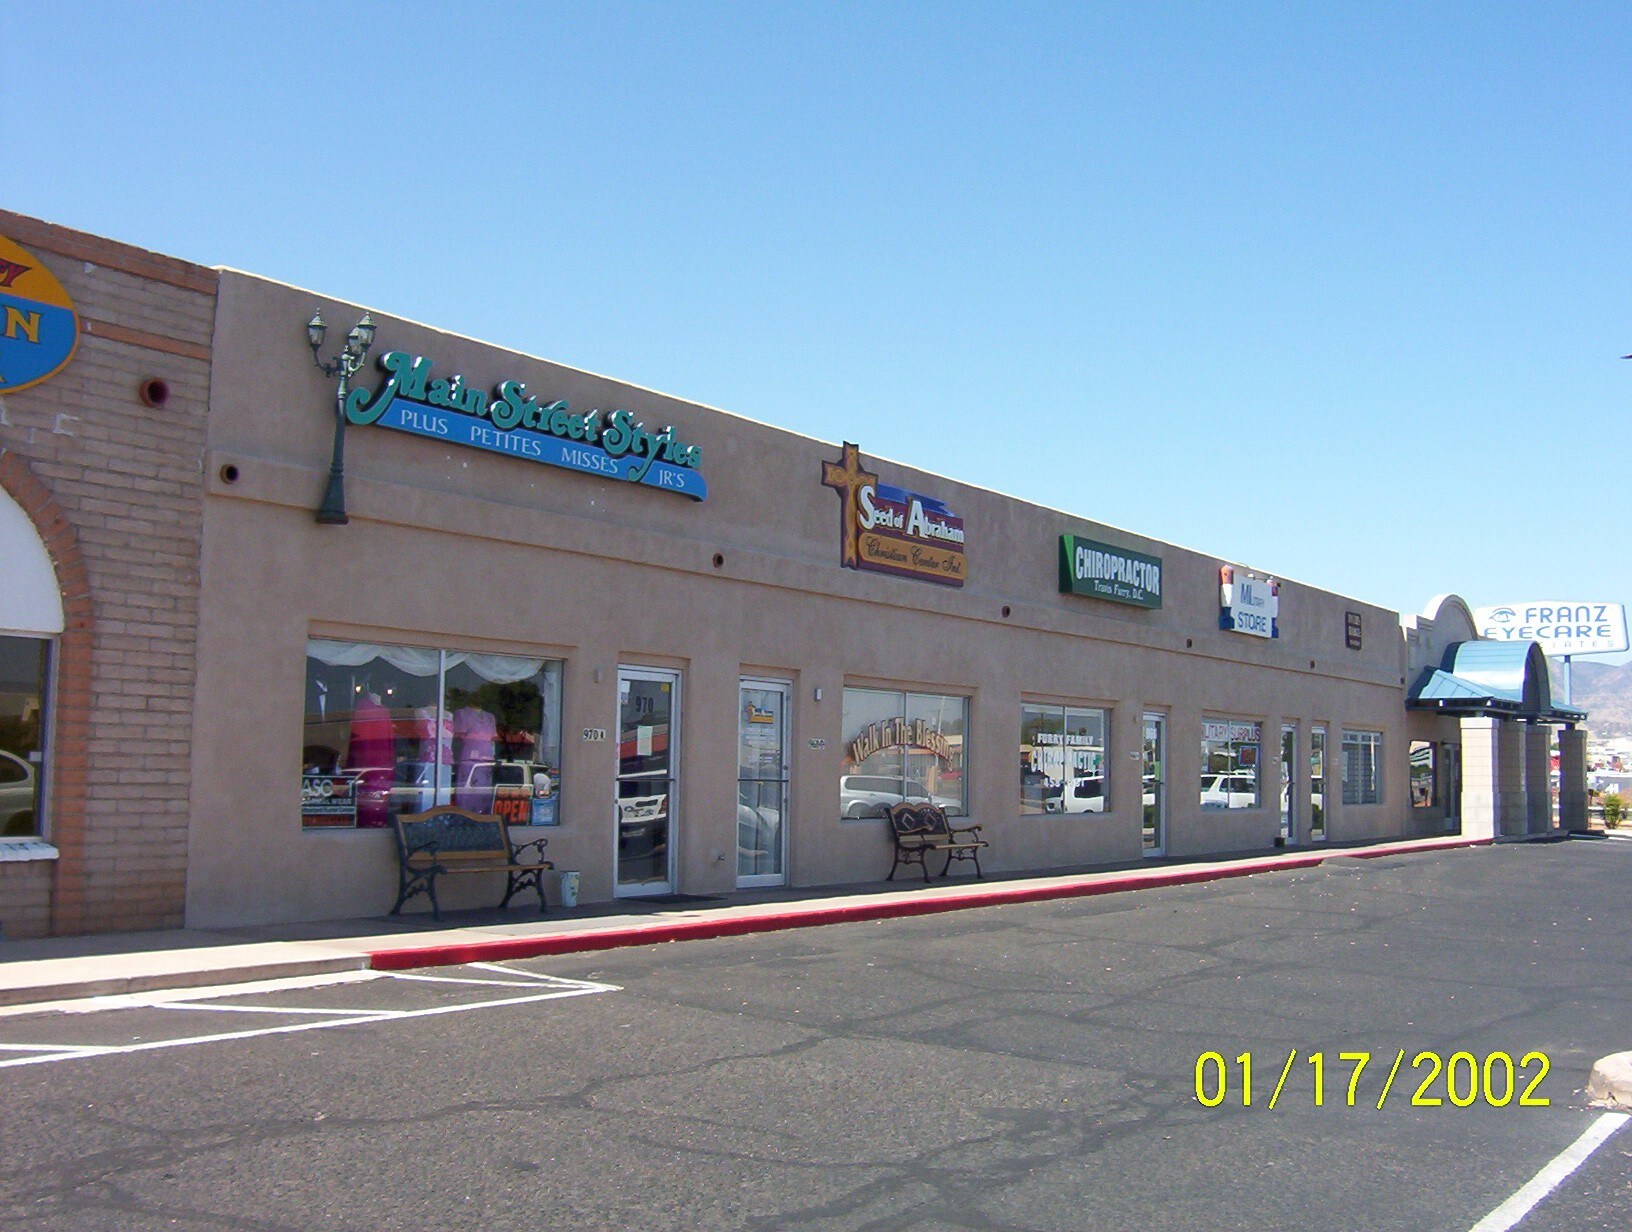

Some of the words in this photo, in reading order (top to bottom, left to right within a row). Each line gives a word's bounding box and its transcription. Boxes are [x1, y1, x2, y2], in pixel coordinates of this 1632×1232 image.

[346, 351, 488, 425] Main
[490, 380, 600, 442] Street
[602, 409, 702, 482] Styles
[400, 408, 449, 435] PLUS
[470, 425, 542, 457] PETITES
[560, 446, 619, 475] MISSES
[658, 468, 686, 489] JR'S
[858, 485, 893, 529] Seed
[907, 499, 964, 544] Abraham
[1075, 545, 1160, 596] CHIROPRACTOR
[1237, 611, 1267, 632] STORE
[1483, 624, 1611, 640] EYECARE
[1525, 605, 1608, 623] FRANZ
[635, 696, 655, 713] 970
[852, 723, 881, 766] Walk
[881, 719, 892, 748] In
[893, 716, 914, 746] The
[494, 800, 529, 822] OPEN
